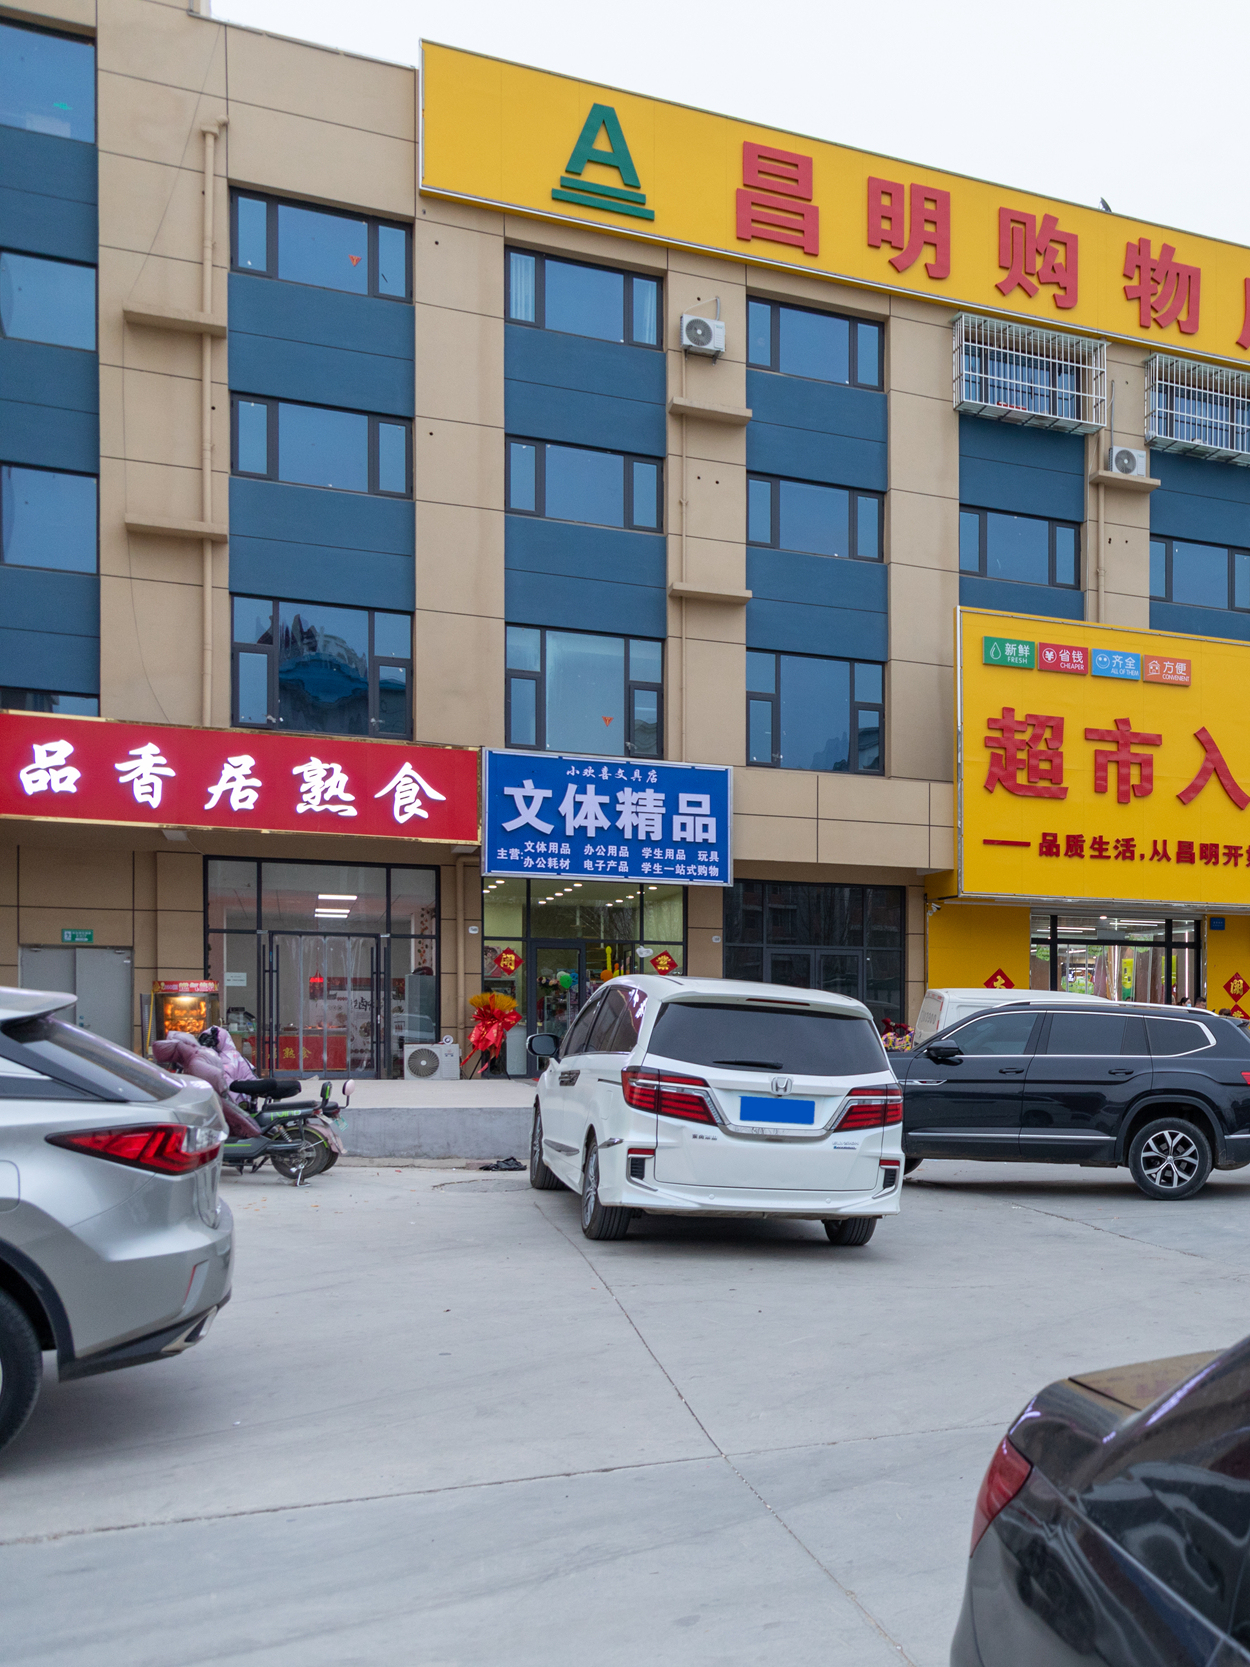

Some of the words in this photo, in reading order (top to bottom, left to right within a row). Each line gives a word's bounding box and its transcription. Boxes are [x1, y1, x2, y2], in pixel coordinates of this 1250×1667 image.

[1004, 643, 1030, 657] 新鲜
[1058, 649, 1084, 664] 省钱
[1007, 656, 1028, 664] FRESH
[1059, 662, 1085, 671] CHEAPER
[1111, 655, 1136, 669] 齐全
[1162, 660, 1187, 676] 方便
[1162, 673, 1190, 683] CONVENIENT
[18, 738, 447, 825] 品香居熟食
[566, 765, 659, 784] 小欢喜文具店
[501, 779, 718, 844] 文体精品
[524, 840, 571, 855] 文体用品
[583, 843, 630, 858] 办公用品
[641, 846, 687, 861] 学生用品
[697, 850, 720, 863] 玩具
[523, 856, 571, 870] 办公耗材
[583, 859, 630, 873] 电子产品
[641, 861, 720, 877] 学生一站式购物
